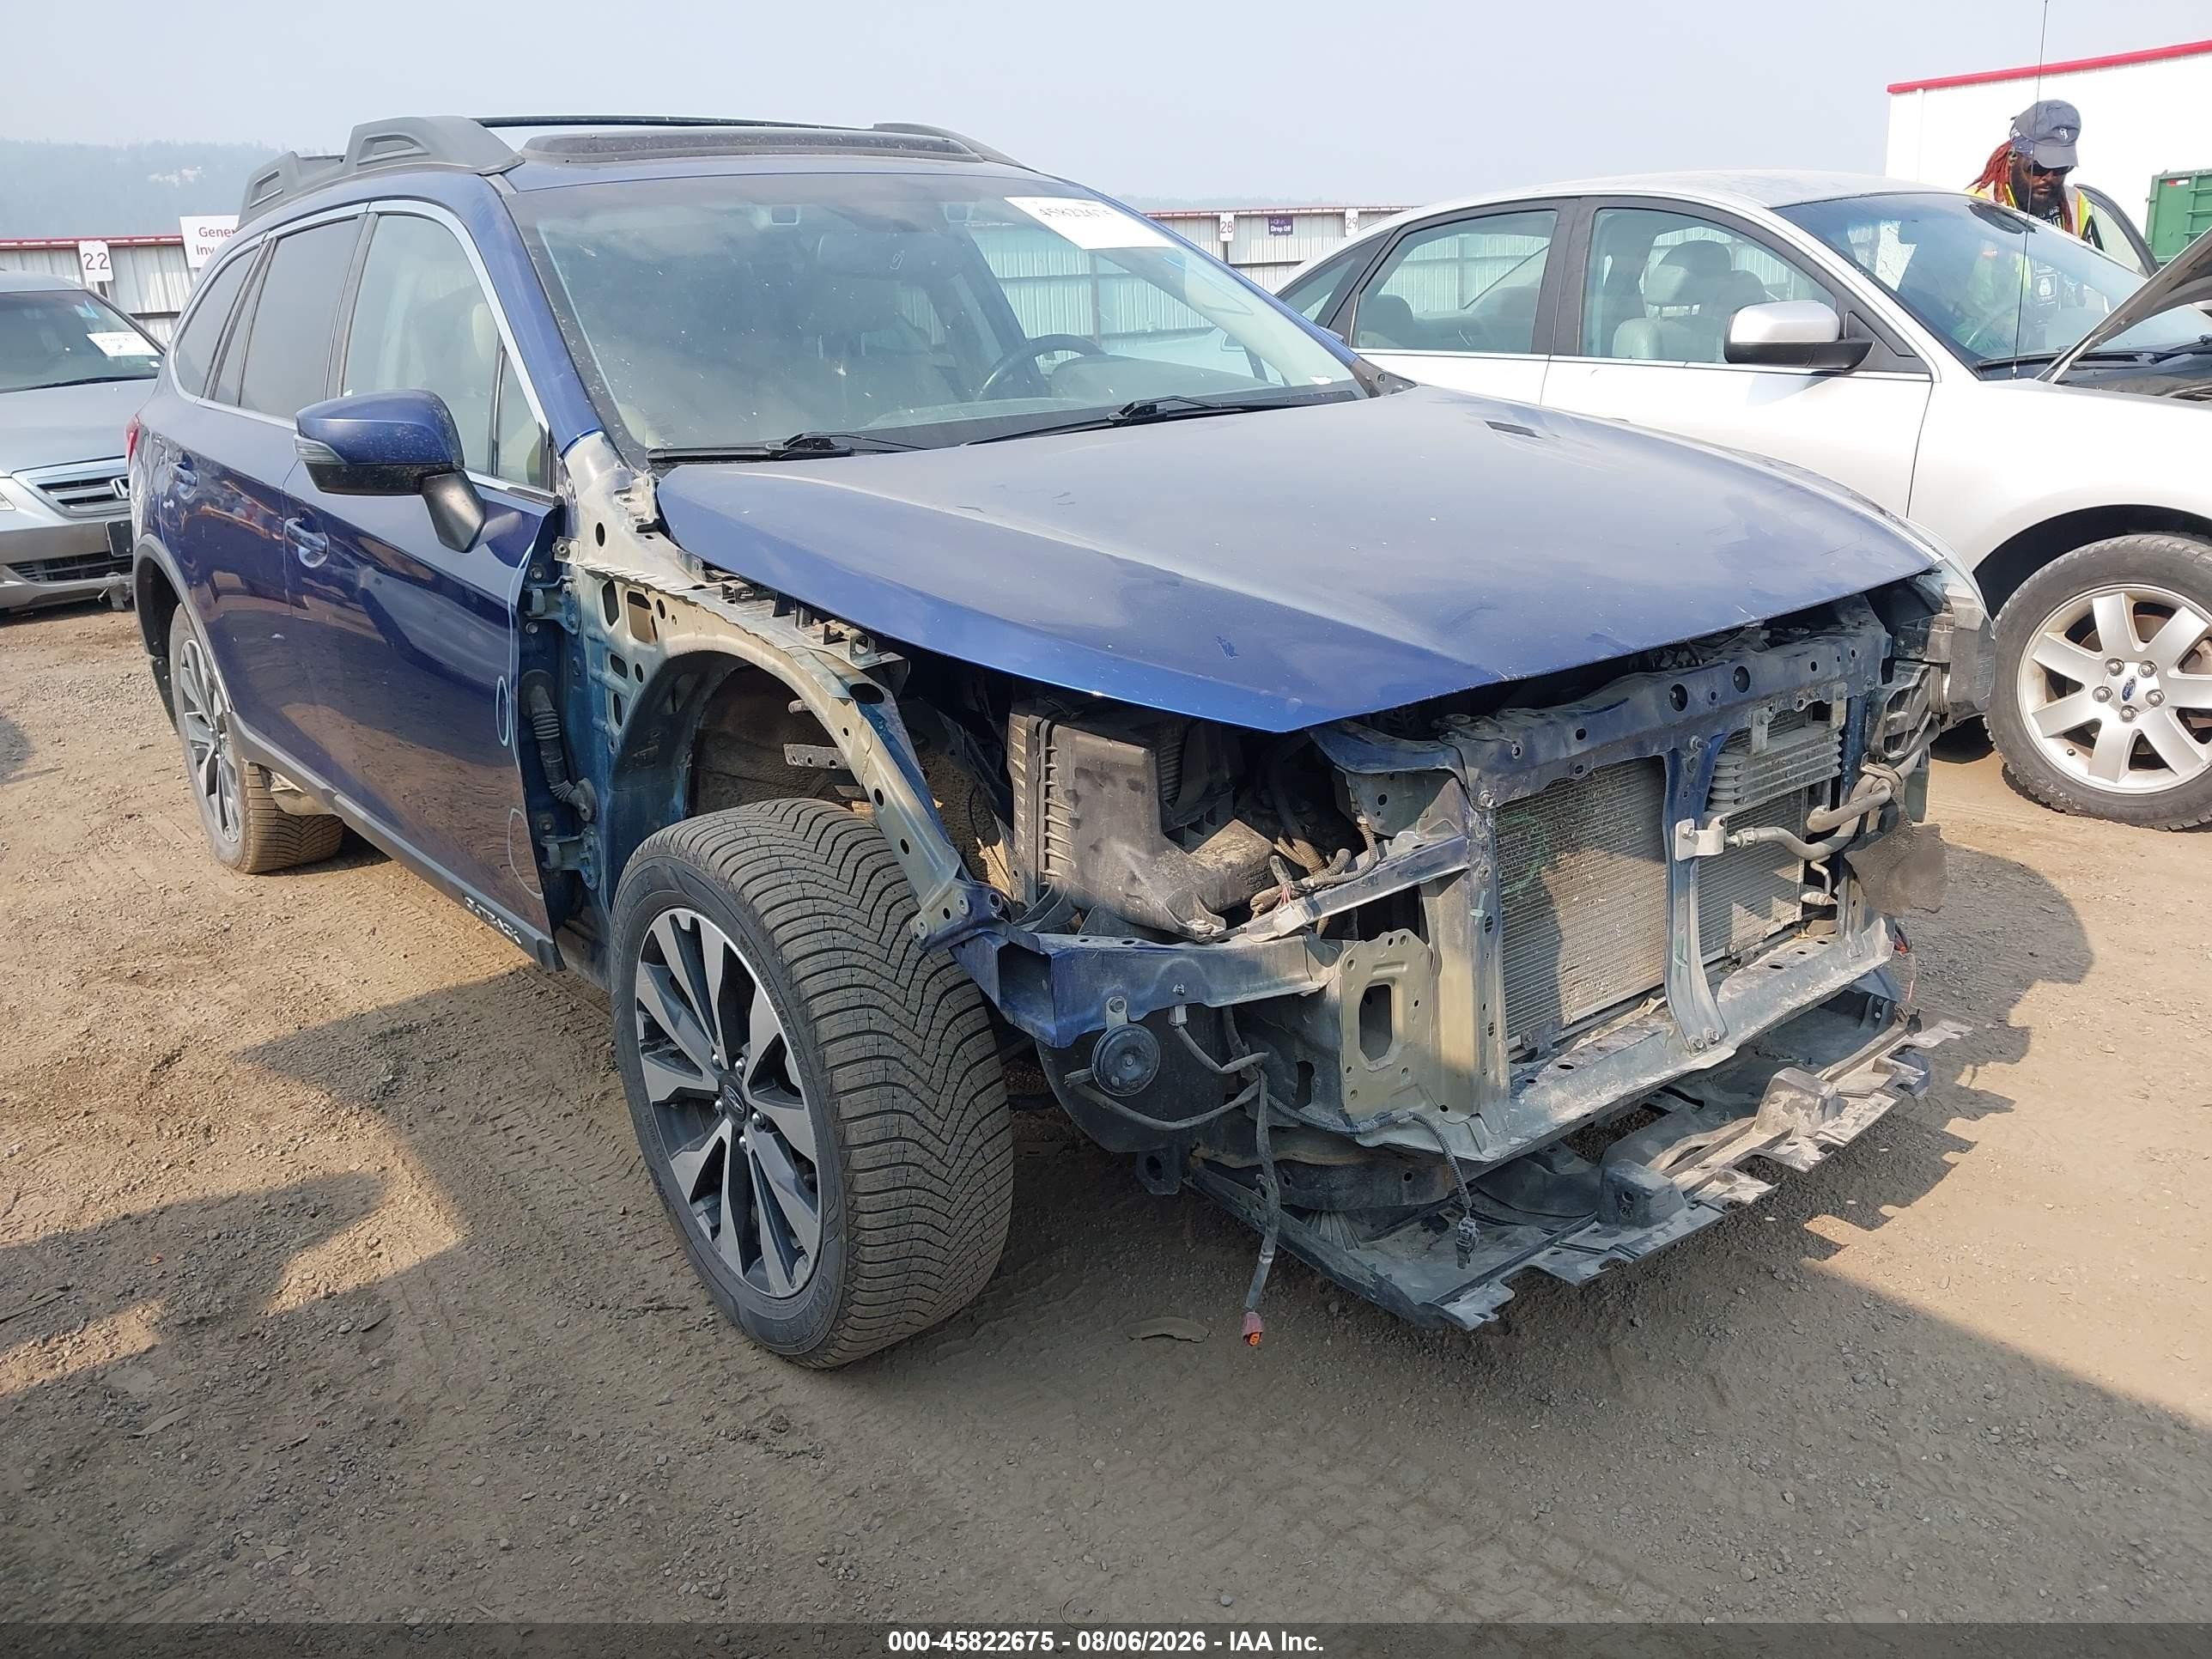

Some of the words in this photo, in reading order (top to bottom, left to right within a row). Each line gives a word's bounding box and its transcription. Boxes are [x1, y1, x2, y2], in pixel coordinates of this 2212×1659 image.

[1220, 220, 1233, 234] 28
[1346, 216, 1358, 229] 29
[1270, 225, 1283, 234] Drop
[82, 252, 110, 270] 22
